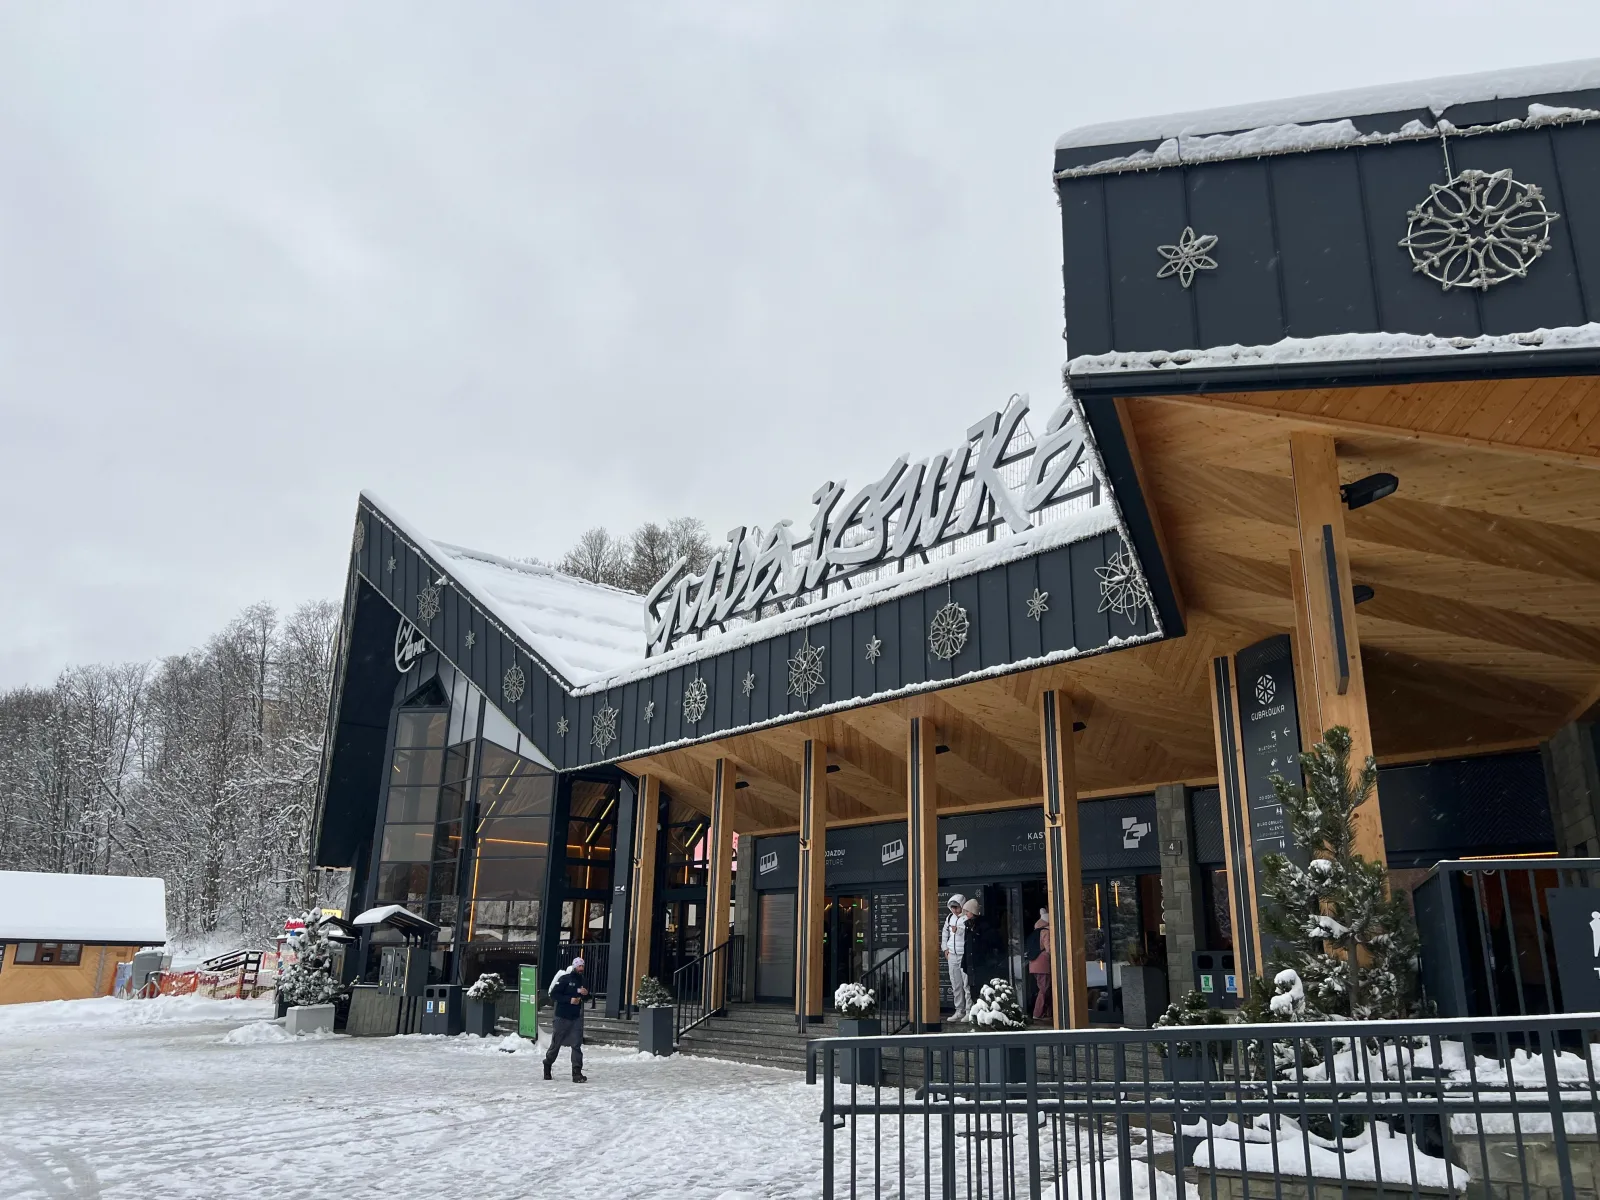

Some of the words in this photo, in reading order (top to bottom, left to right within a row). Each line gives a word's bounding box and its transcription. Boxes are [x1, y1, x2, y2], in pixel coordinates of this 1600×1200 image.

[1011, 842, 1038, 852] TICKET
[1168, 842, 1175, 851] 4
[825, 857, 845, 866] RTURE
